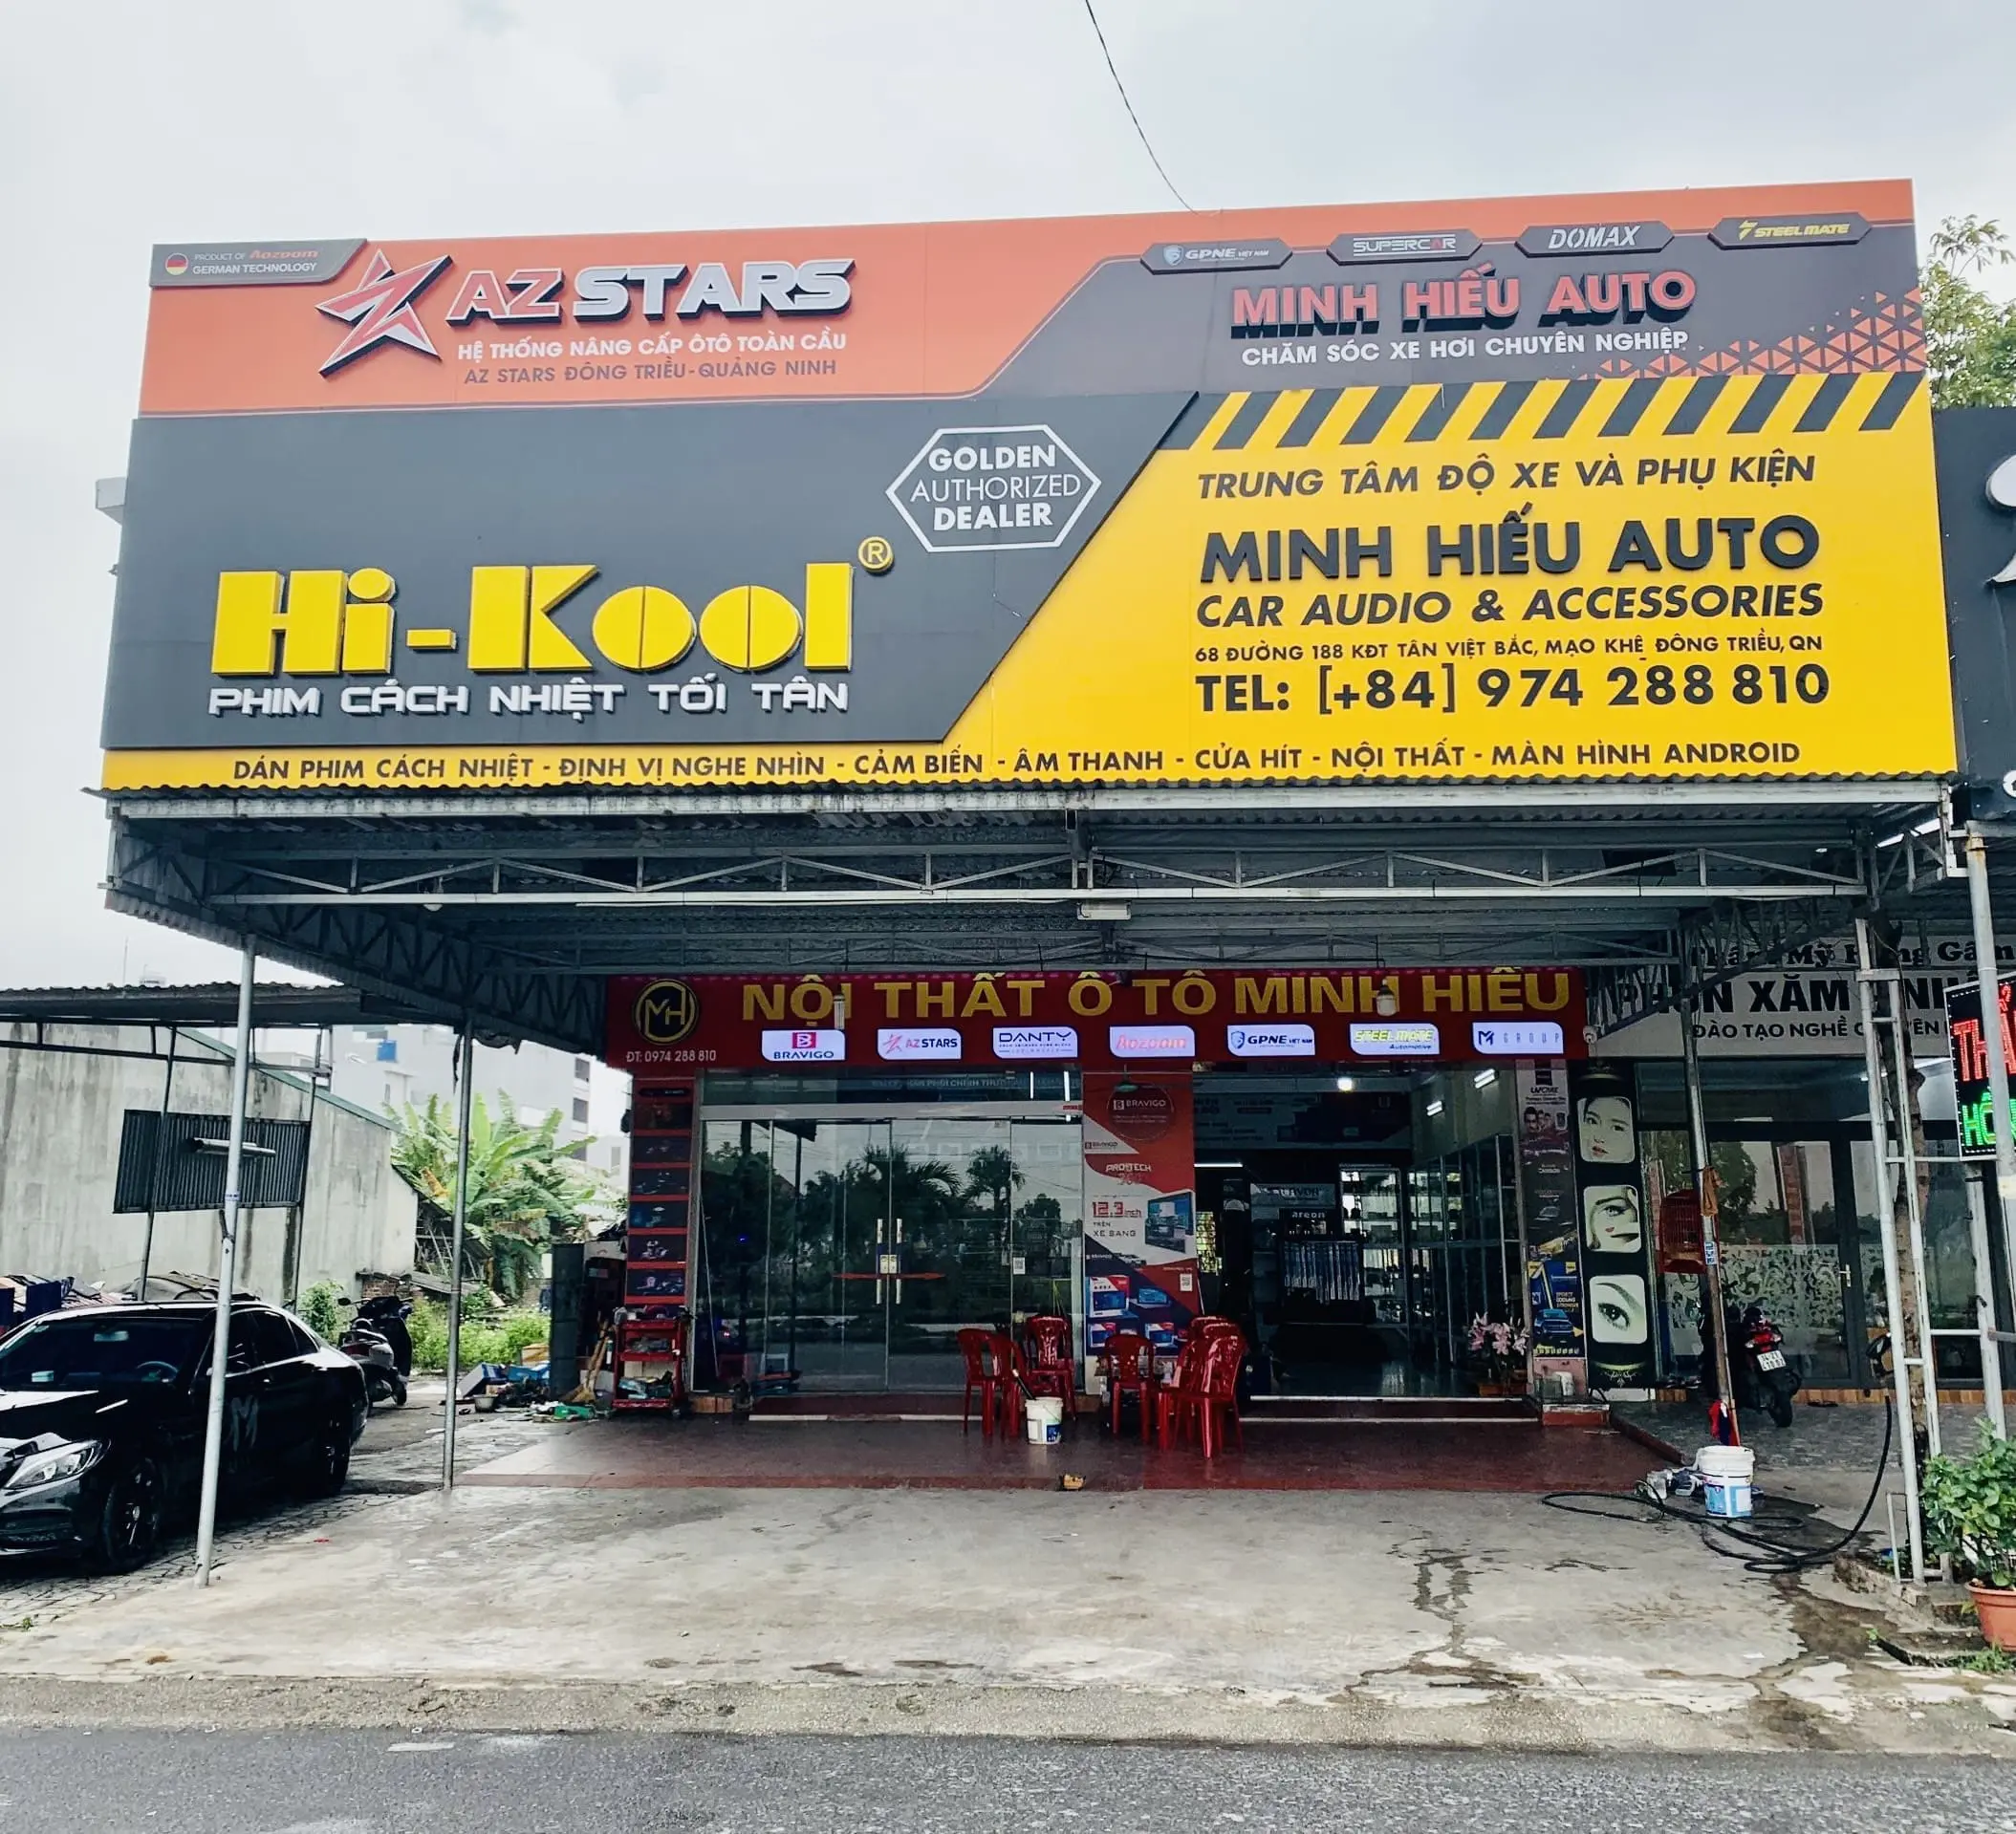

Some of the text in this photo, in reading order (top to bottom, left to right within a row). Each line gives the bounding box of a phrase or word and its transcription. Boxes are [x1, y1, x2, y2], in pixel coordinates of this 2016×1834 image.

[1353, 237, 1457, 253] SUPERCAR
[1548, 226, 1641, 249] DOMAX
[192, 262, 318, 275] GERMAN TECHNOLOGY
[194, 252, 232, 261] PRODUCT
[249, 249, 318, 259] Aozoom
[1184, 248, 1237, 260] GPNE
[445, 259, 856, 323] AZ STARS
[1232, 263, 1698, 334] MINH HIẾU AUTO
[459, 325, 848, 362] HỆ THỐNG NÂNG CẤP ÔTÔ TOÀN CẦU
[1242, 327, 1689, 366] CHĂM SÓC XE HƠI CHUYÊN NGHIỆP
[464, 368, 489, 385] AZ
[497, 366, 556, 384] STARS
[563, 360, 628, 381] ĐÔNG
[785, 359, 837, 376] NINH
[928, 443, 1056, 472] GOLDEN
[1197, 448, 1816, 499] TRUNG TÂM ĐỘ XE VÀ PHỤ KIỆN
[909, 474, 1081, 503] AUTHORIZED
[933, 502, 1053, 531] DEALER
[1200, 501, 1821, 584] MINH HIẾU AUTO
[210, 562, 856, 677] Hi-Kool
[1195, 581, 1825, 629] CAR AUDIO & ACCESSORIES
[1195, 646, 1221, 663] 68
[1225, 640, 1305, 663] ĐƯỜNG
[1311, 643, 1345, 661] 188
[1352, 642, 1390, 660] KĐT
[1397, 637, 1438, 658] TÂN
[1444, 637, 1487, 660] VIỆT
[1494, 635, 1539, 658] BẮC,
[1545, 637, 1596, 658] MẠO
[1655, 633, 1720, 655] ĐÔNG
[1726, 628, 1787, 655] TRIỀU,
[1788, 636, 1824, 653] QN
[208, 672, 850, 723] PHIM CÁCH NHIỆT TỐI TÂN
[1194, 661, 1831, 715] TEL: [+84] 974 288 810
[232, 754, 291, 781] DÁN
[299, 758, 366, 780] PHIM
[377, 753, 446, 780] CÁCH
[458, 751, 534, 783] NHIỆT
[558, 756, 628, 786] ĐỊNH
[637, 756, 668, 785] VỊ
[672, 755, 748, 778] NGHE
[755, 749, 827, 777] NHÌN
[854, 747, 916, 775] CẢM
[924, 743, 985, 774] BIẾN
[1012, 745, 1062, 774] ÂM
[1069, 749, 1165, 772] THANH
[1193, 745, 1251, 771] CỬA
[1260, 743, 1302, 769] HÍT
[1332, 742, 1390, 773] NỘI
[1396, 735, 1467, 767] THẤT
[1491, 742, 1565, 767] MÀN
[1576, 740, 1652, 766] HÌNH
[1663, 741, 1802, 765] ANDROID
[742, 974, 854, 1027] NỘI
[874, 971, 1046, 1019] THẤT
[1068, 971, 1114, 1017] Ô
[1132, 970, 1217, 1016] TÔ
[1234, 975, 1401, 1014] MINH
[1747, 973, 1852, 1014] XĂM
[921, 1037, 958, 1048] STARS
[999, 1031, 1072, 1043] DANTY
[1247, 1034, 1288, 1045] GPNE
[1691, 1019, 1739, 1039] ĐÀO
[1742, 1024, 1786, 1041] TẠO
[1795, 1015, 1849, 1038] NGHỀ
[644, 1049, 671, 1063] 0974
[674, 1049, 697, 1062] 288
[698, 1049, 717, 1062] 810
[773, 1050, 835, 1060] BRAVIGO
[1126, 1099, 1166, 1108] BRAVIGO
[1092, 1201, 1124, 1218] 12.3
